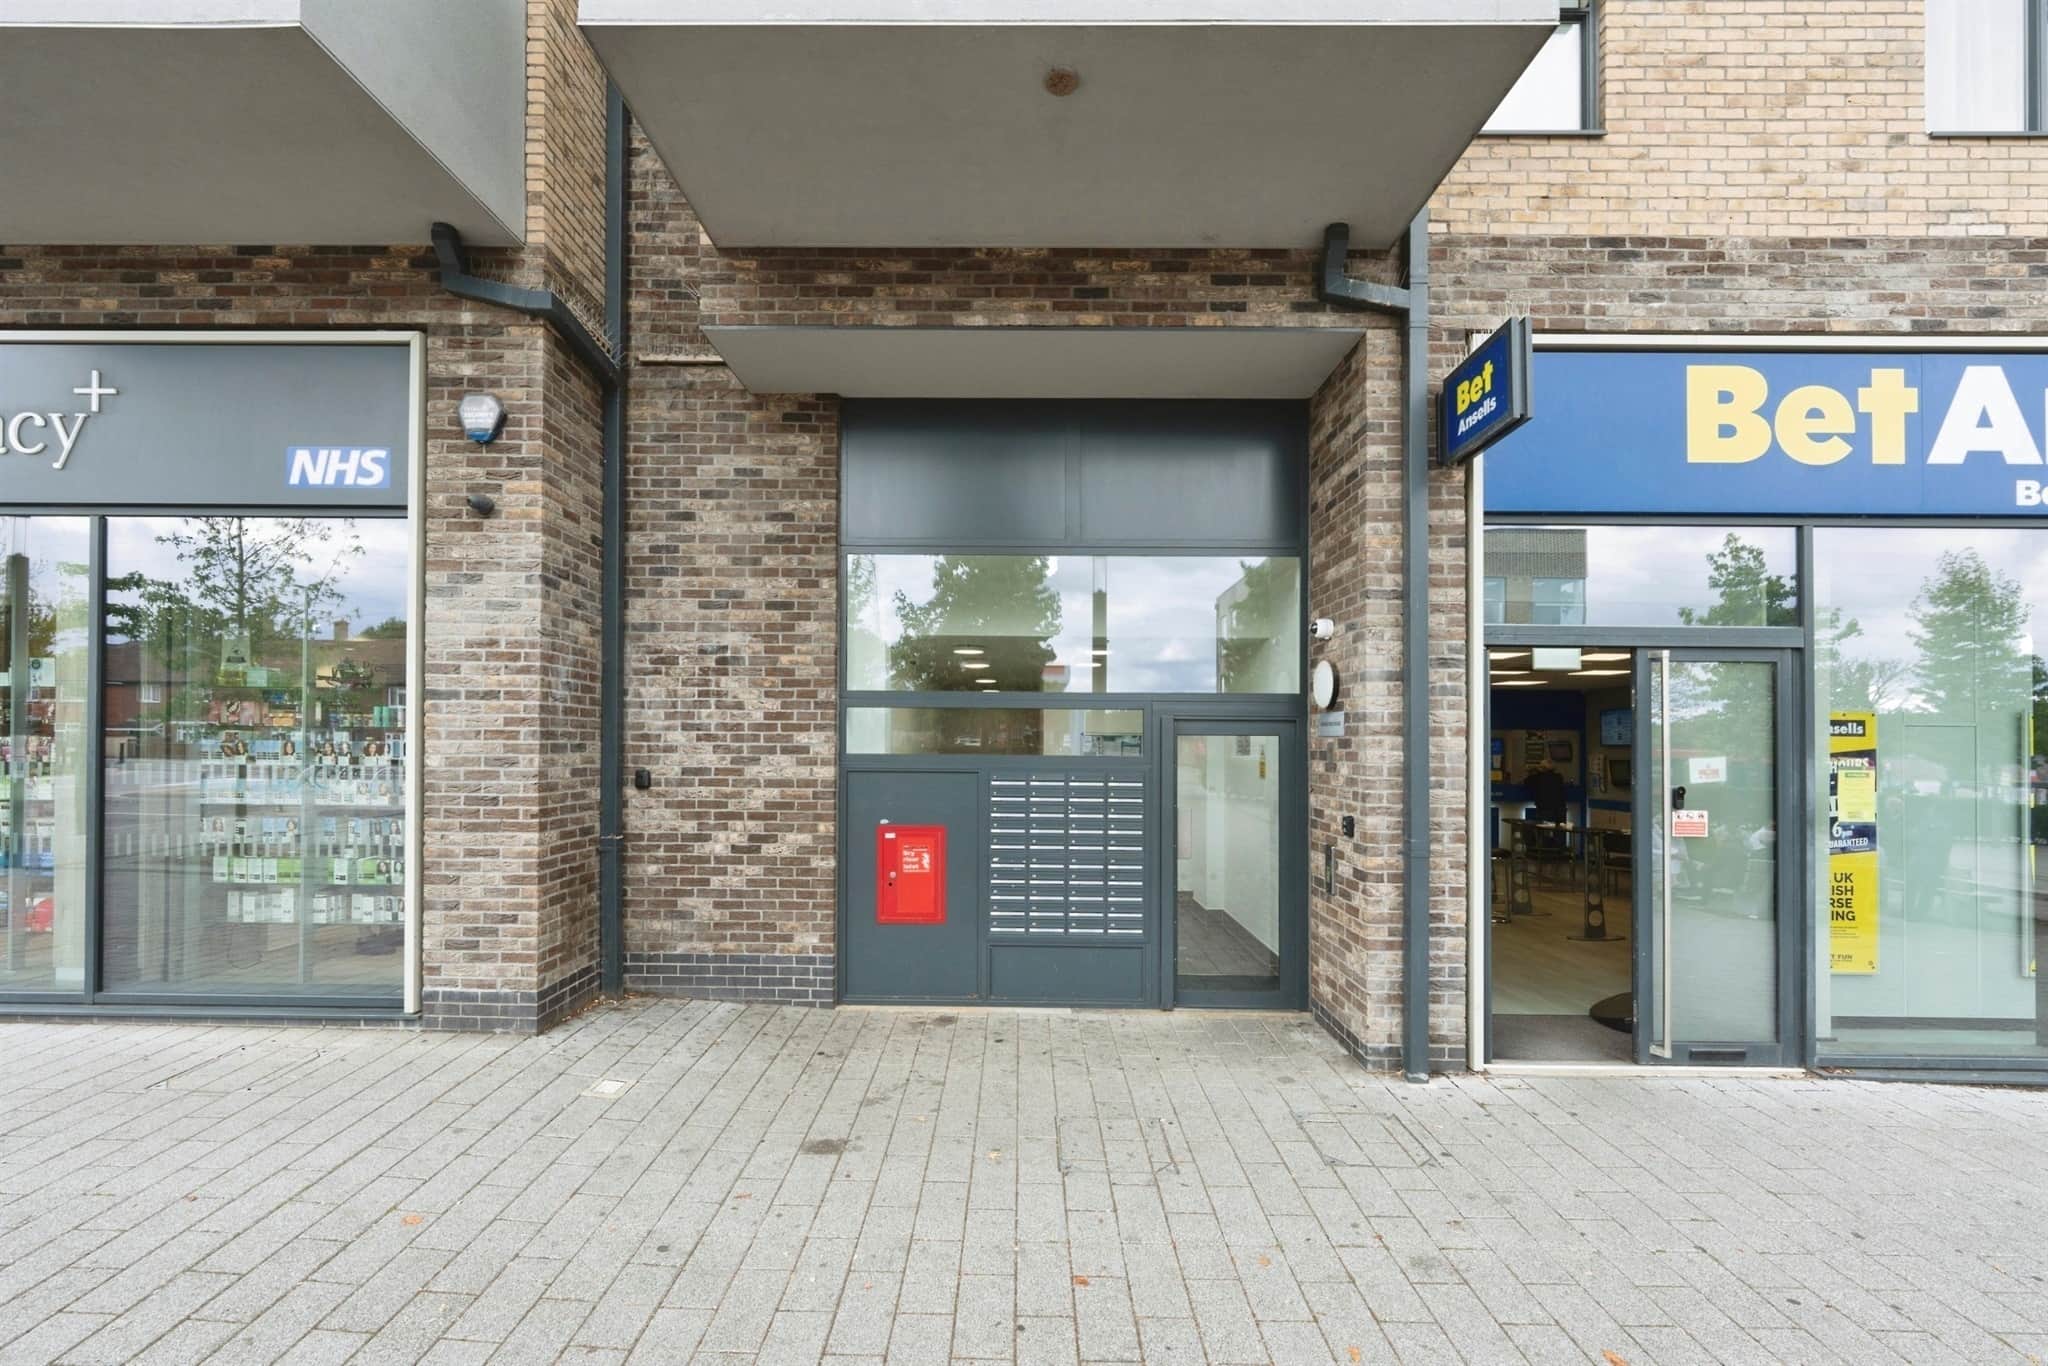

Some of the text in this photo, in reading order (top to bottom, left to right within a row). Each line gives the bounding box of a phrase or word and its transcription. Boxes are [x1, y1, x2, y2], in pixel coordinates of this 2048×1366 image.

[1457, 360, 1494, 415] Bet
[1457, 397, 1497, 436] Ansells
[288, 448, 387, 486] NHS
[1834, 872, 1854, 883] UK
